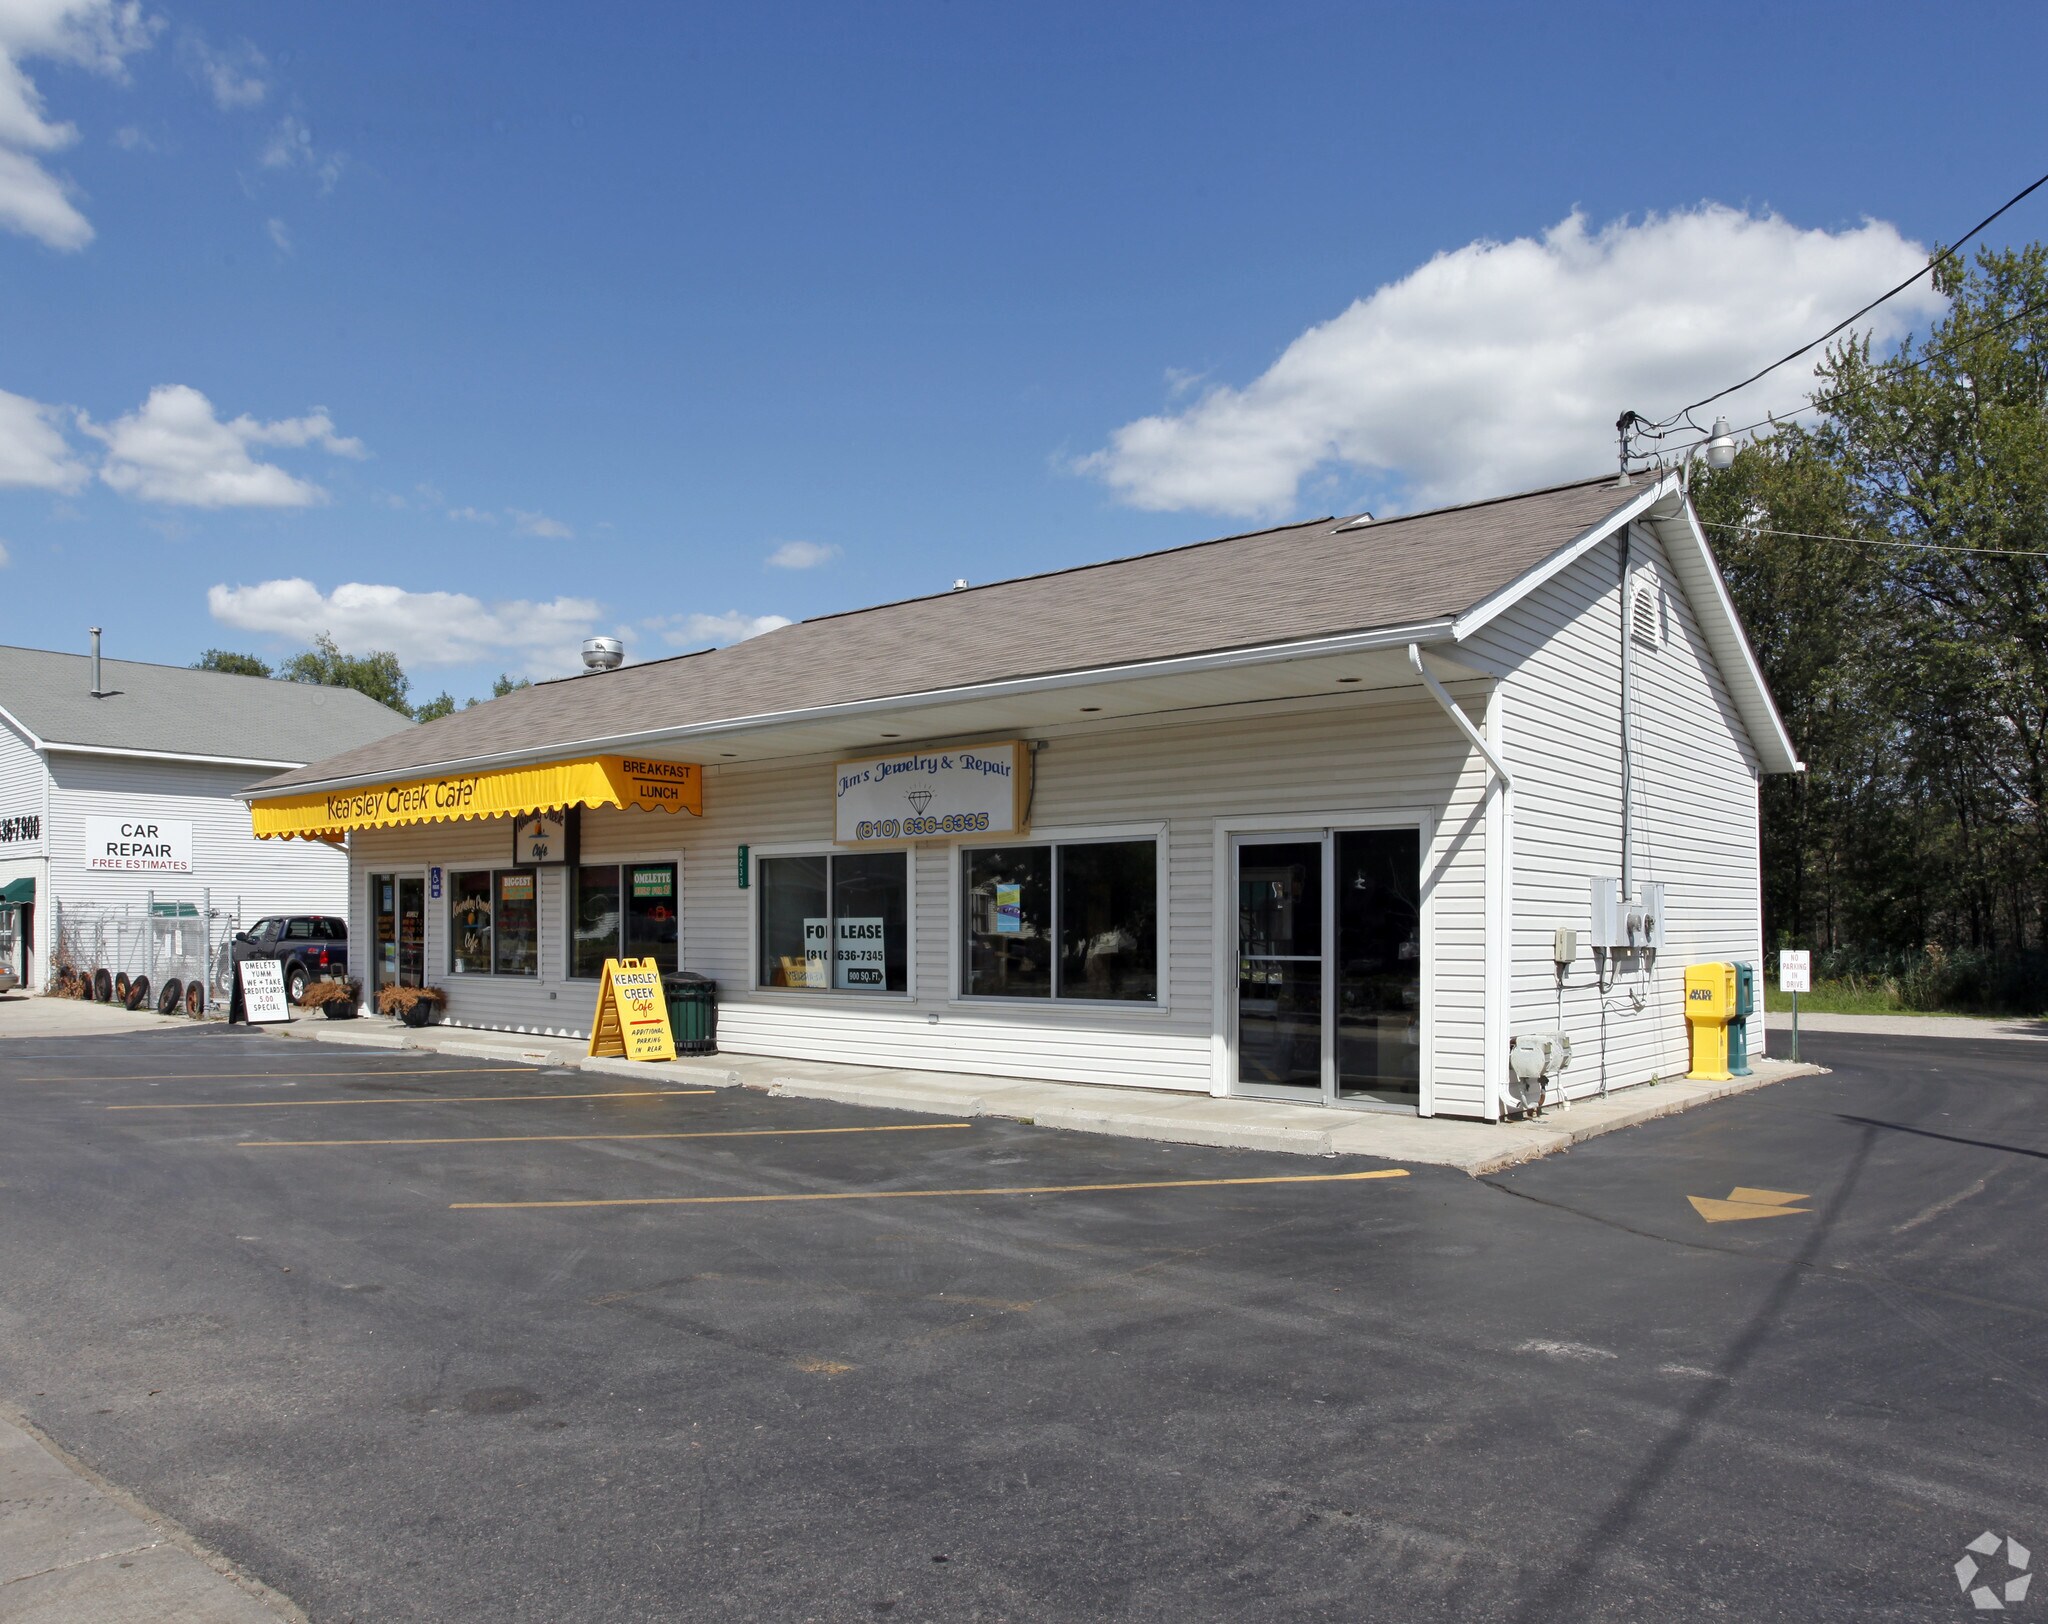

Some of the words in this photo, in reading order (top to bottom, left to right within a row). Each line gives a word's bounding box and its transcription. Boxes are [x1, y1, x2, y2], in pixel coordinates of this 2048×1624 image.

[623, 760, 690, 778] BREAKFAST
[838, 770, 870, 798] Jim's
[874, 755, 938, 782] Jewelry
[941, 755, 954, 769] &
[960, 754, 1011, 777] Repair
[640, 785, 678, 800] LUNCH
[327, 791, 383, 820] Kearsley
[386, 784, 430, 814] Creek
[0, 815, 40, 842] 36-7900
[120, 824, 158, 838] CAR
[856, 819, 900, 841] (810)
[903, 812, 990, 835] 636-6335
[106, 842, 172, 858] REPAIR
[532, 844, 548, 860] Cafe
[92, 858, 122, 868] FREE
[126, 860, 188, 870] ESTIMATES
[504, 877, 531, 886] BIGGEST
[634, 872, 671, 884] OMELETTE
[806, 925, 827, 939] FO
[840, 925, 882, 939] LEASE
[838, 950, 883, 961] 636-7345
[614, 973, 658, 985] KEARSLEY
[849, 972, 860, 980] 900
[860, 972, 871, 982] SQ.
[872, 972, 880, 980] FT.
[624, 988, 655, 999] CREEK
[632, 998, 654, 1018] Cafe
